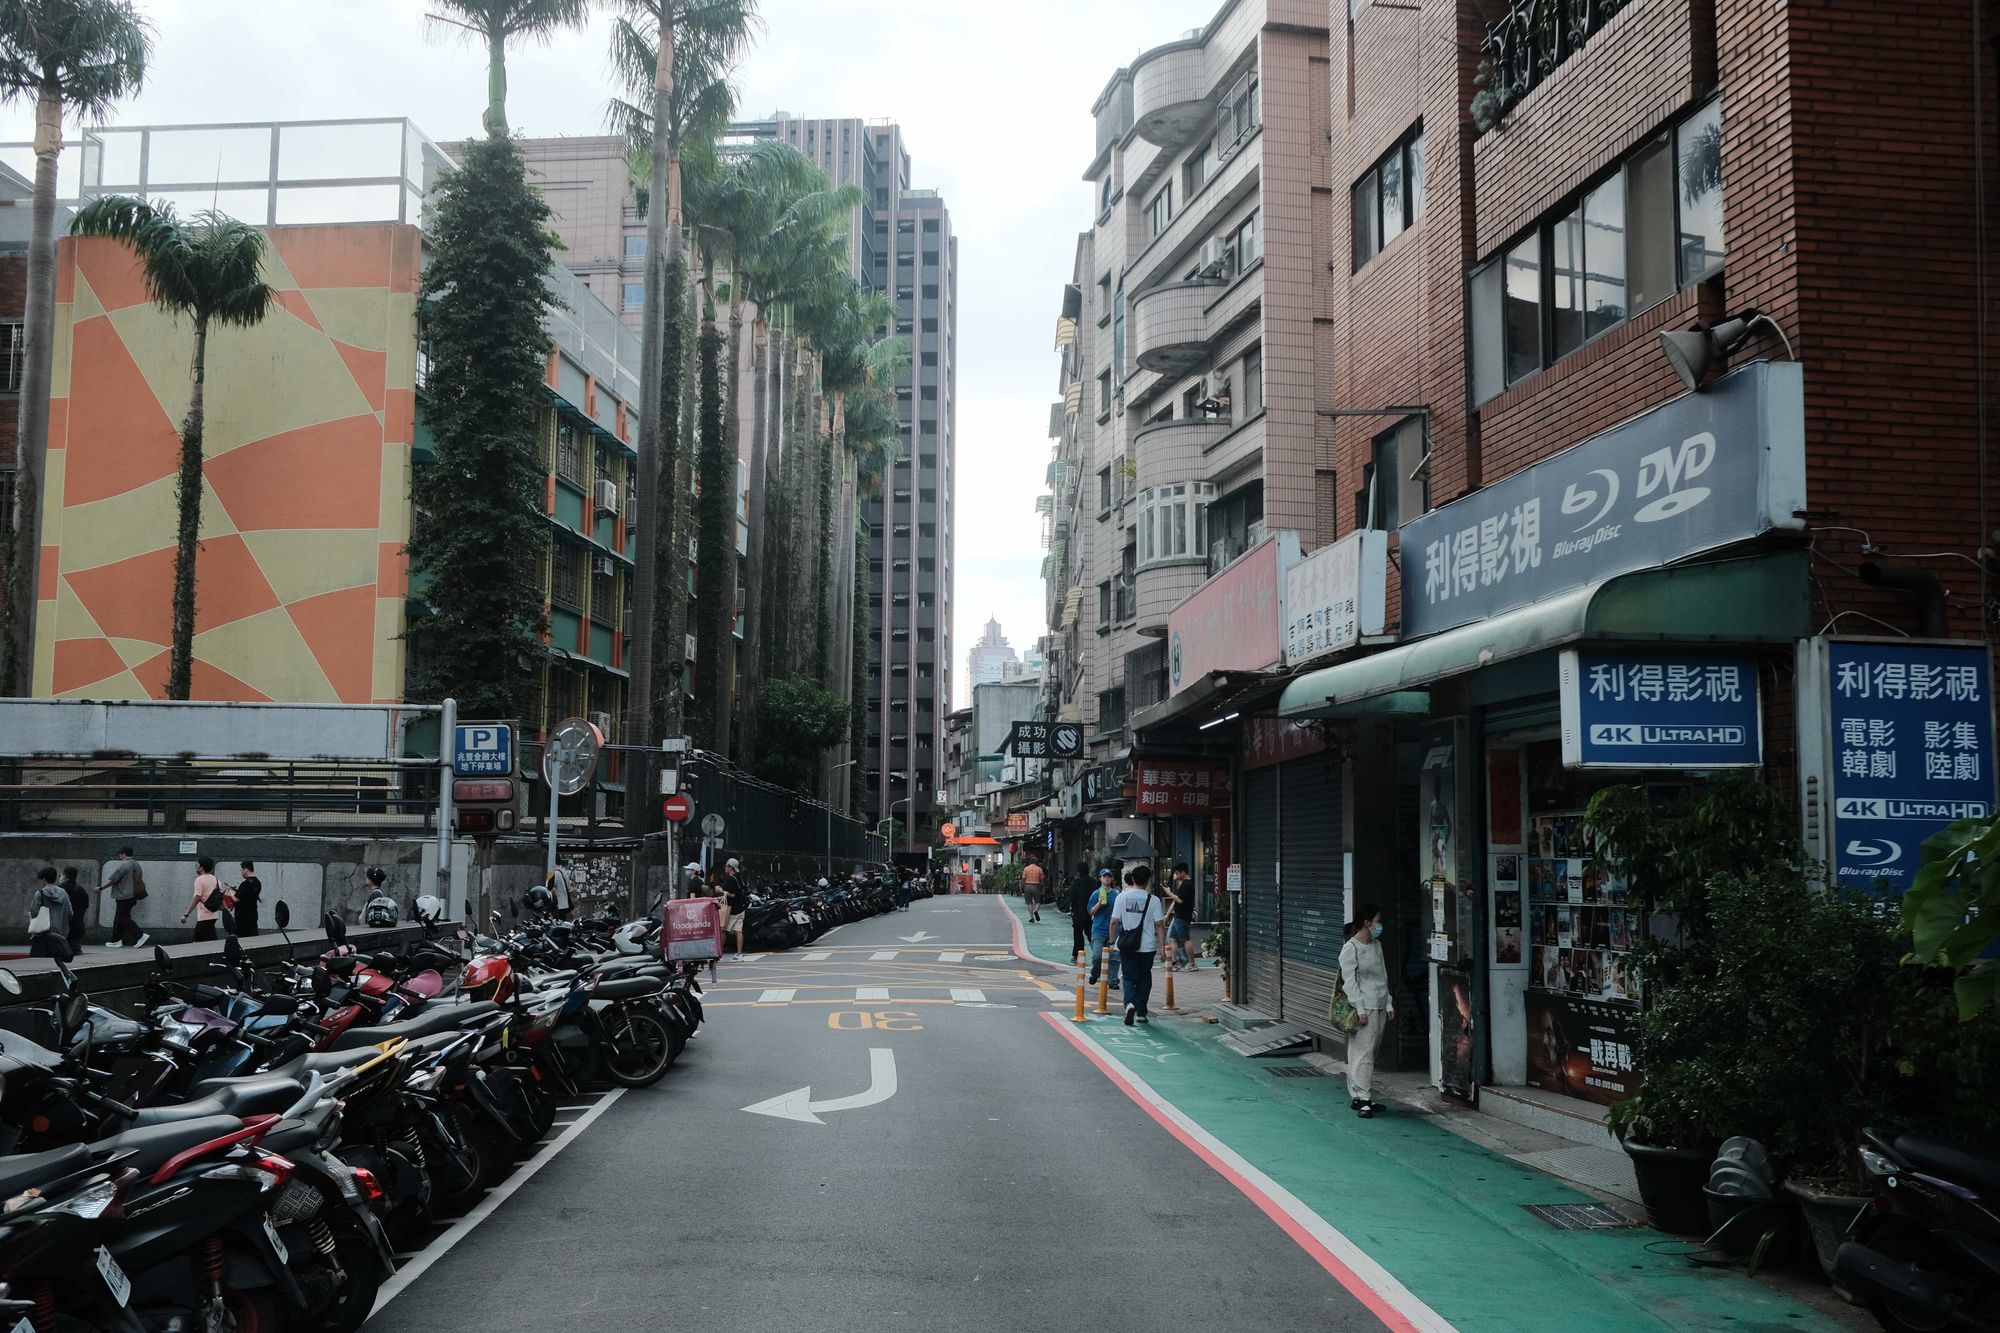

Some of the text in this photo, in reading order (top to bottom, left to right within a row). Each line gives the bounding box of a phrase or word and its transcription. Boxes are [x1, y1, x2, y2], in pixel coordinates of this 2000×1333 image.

[1636, 432, 1716, 495] DVD
[1425, 497, 1541, 603] 利得影視
[1589, 663, 1742, 703] 利得影視
[1837, 662, 1980, 703] 利得影視
[474, 731, 490, 748] P
[1018, 725, 1046, 738] 成功
[1596, 727, 1633, 742] 4K
[1841, 718, 1978, 750] 電影 影集
[1018, 741, 1046, 755] 攝影
[461, 762, 502, 771] 地下停車場
[1842, 750, 1980, 781] 韓劇 陸劇
[1143, 769, 1210, 788] 華美文具
[1843, 802, 1878, 816] 4K
[673, 920, 710, 930] foodpanda
[1577, 1038, 1632, 1072] 一戰再戰
